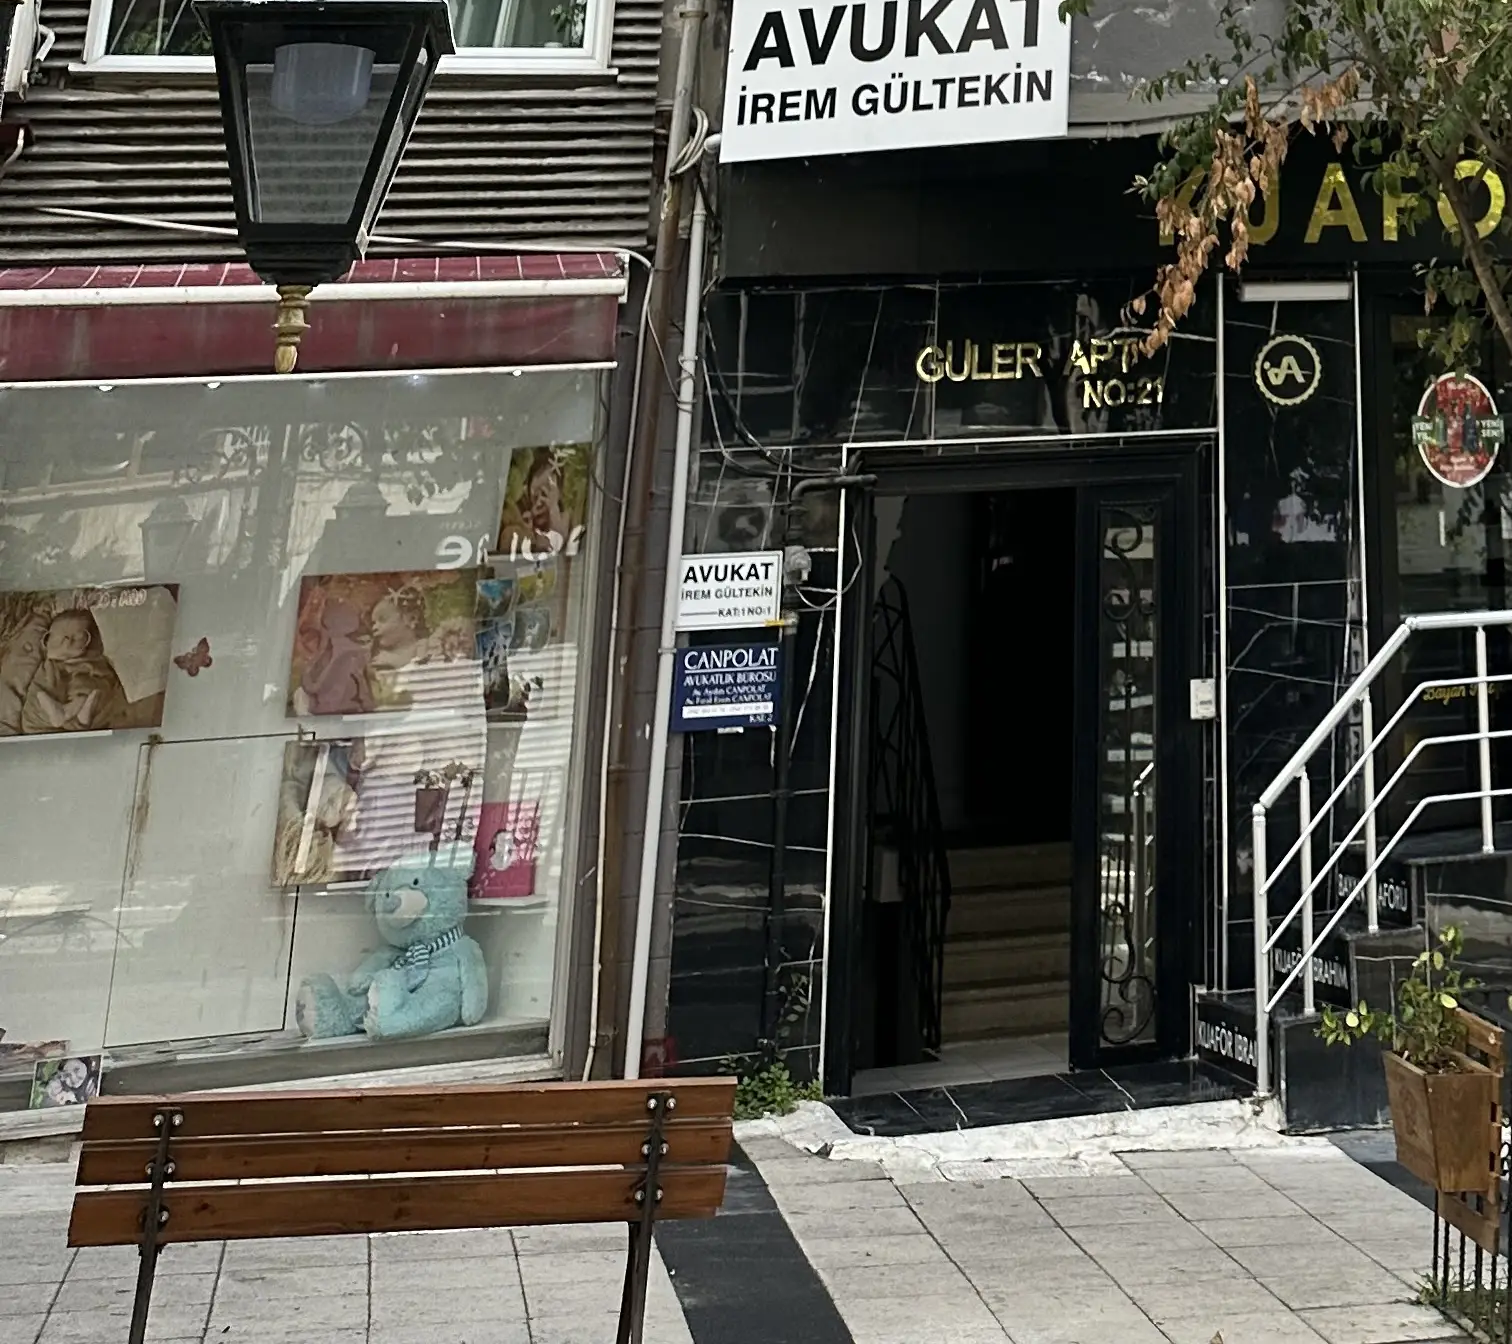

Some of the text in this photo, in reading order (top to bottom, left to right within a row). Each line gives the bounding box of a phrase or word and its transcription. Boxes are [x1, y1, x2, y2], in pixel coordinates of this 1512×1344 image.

[737, 62, 1052, 126] İREM GÜLTEKİN
[1083, 376, 1163, 408] NO:21
[683, 562, 774, 583] AVUKAT
[681, 584, 772, 600] İREM GÜLTEKİN
[684, 648, 778, 669] CANPOLAT
